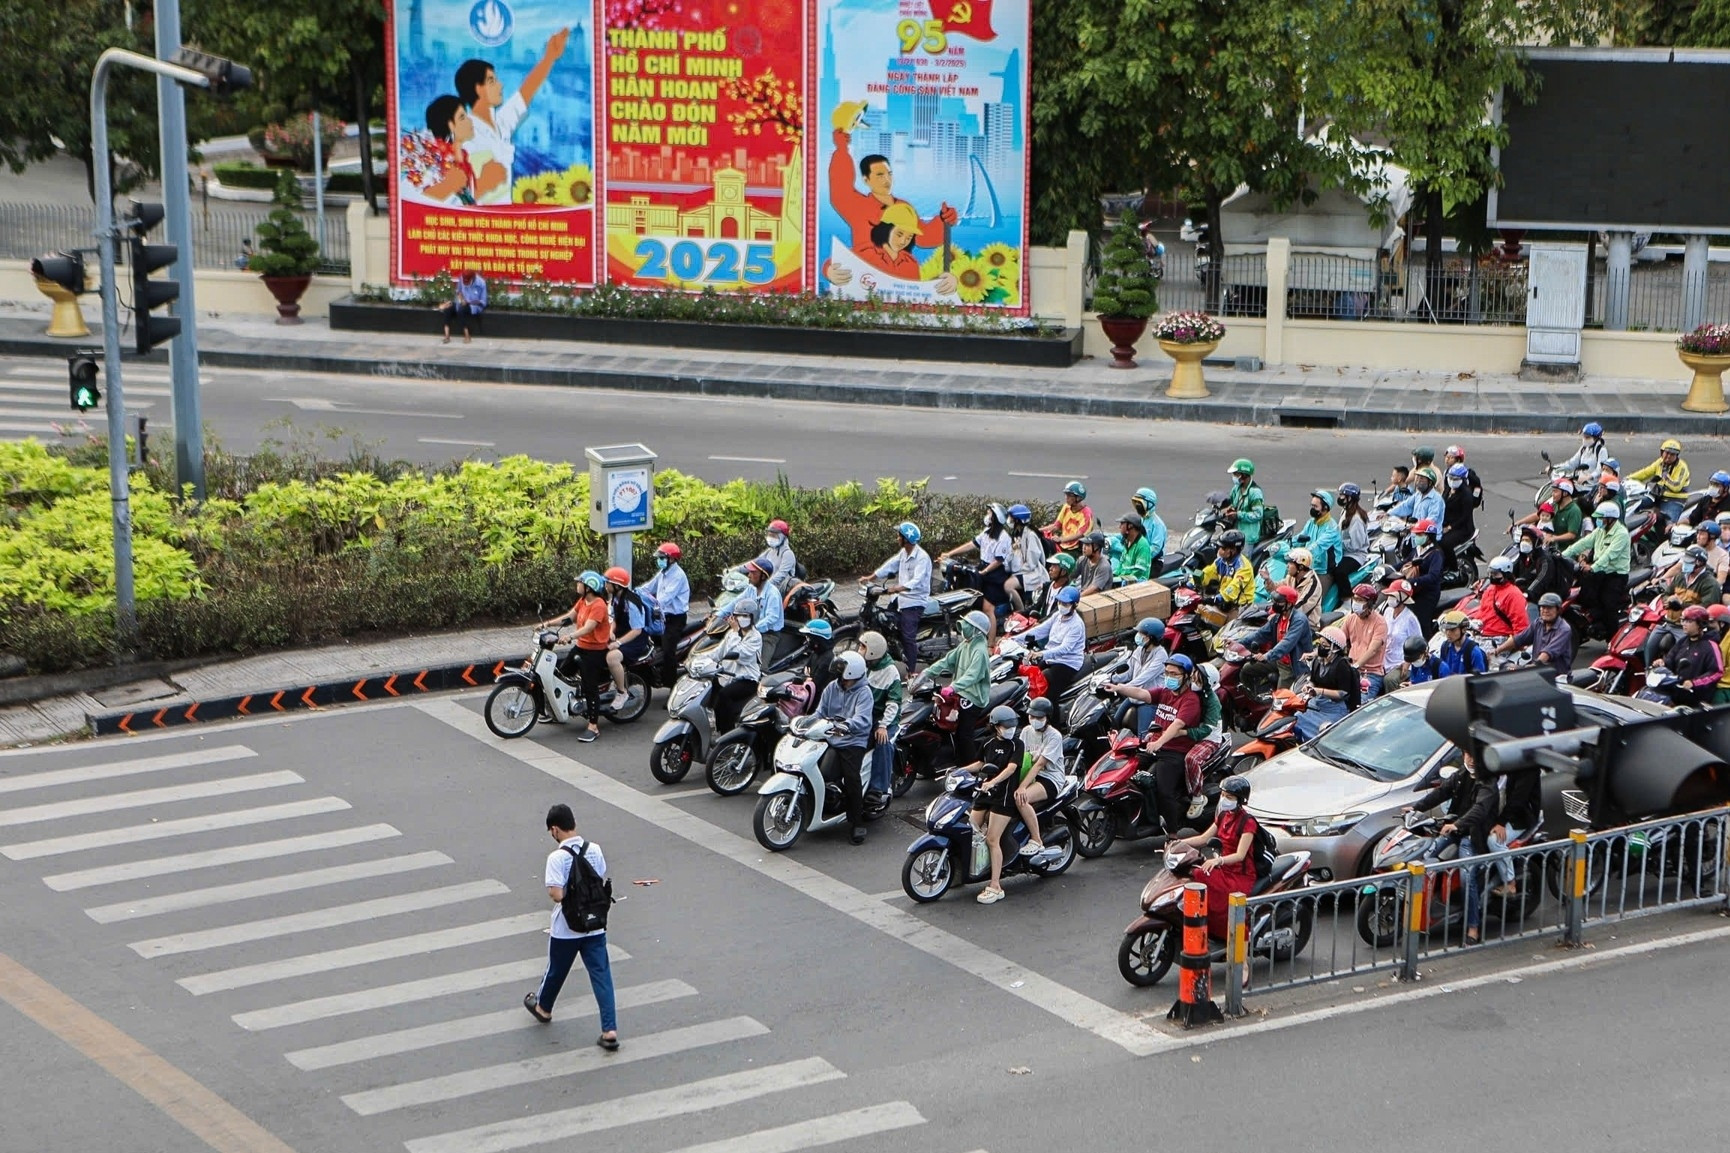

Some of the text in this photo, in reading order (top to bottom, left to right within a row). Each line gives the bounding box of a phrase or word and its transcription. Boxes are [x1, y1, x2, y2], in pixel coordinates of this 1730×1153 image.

[609, 26, 726, 52] THÀNH PHỐ
[896, 19, 965, 56] 95 NĂM
[610, 50, 742, 78] HỒ CHÍ MINH
[611, 76, 718, 100] HÂN HOAN
[888, 71, 958, 83] NGÀY THÀNH LẬP
[939, 84, 956, 96] VIỆT
[958, 86, 979, 96] NAM
[610, 98, 716, 123] CHÀO ĐÓN
[612, 122, 708, 146] NĂM MỚI
[634, 239, 778, 285] 2025
